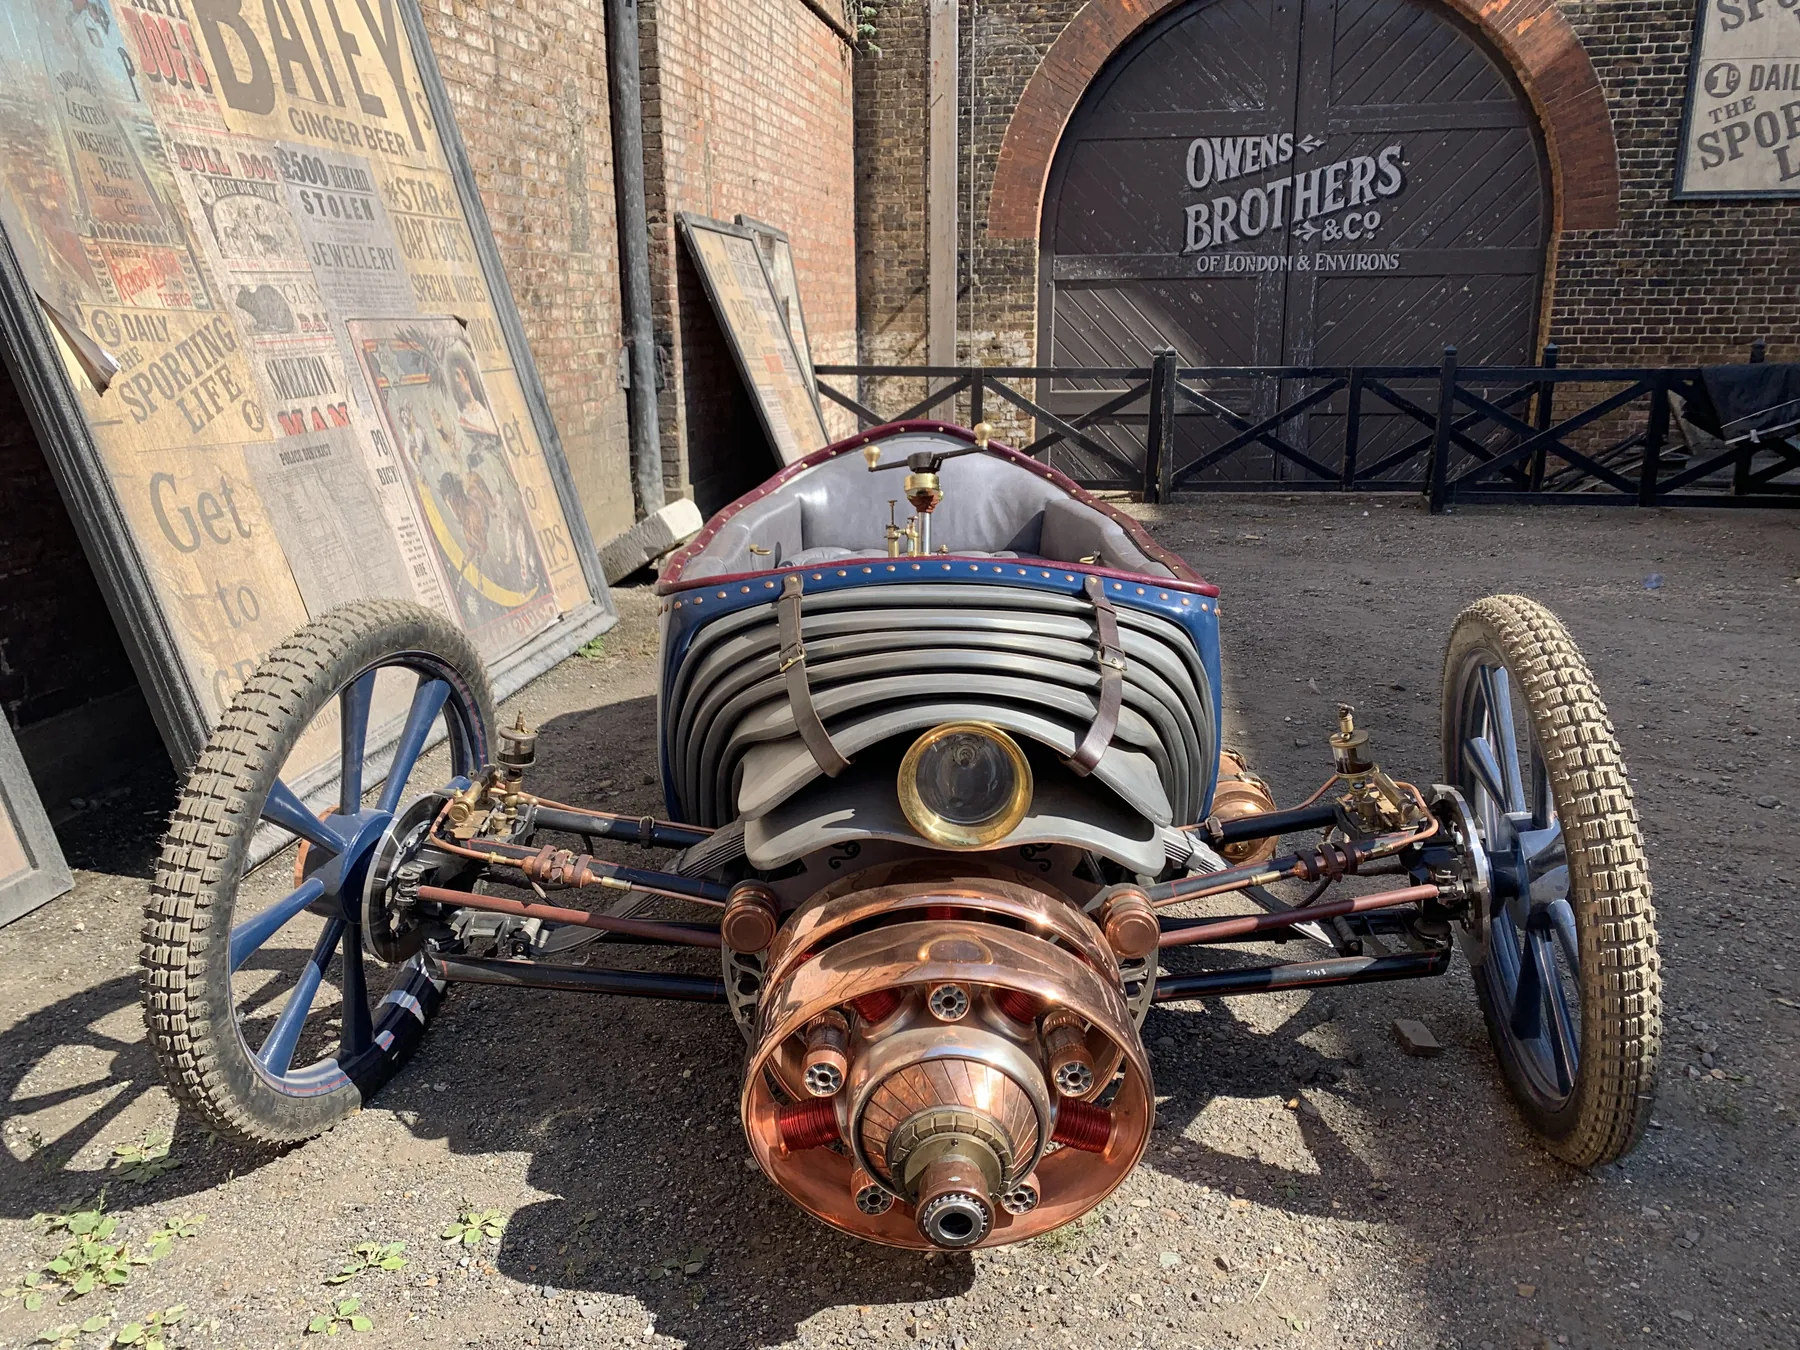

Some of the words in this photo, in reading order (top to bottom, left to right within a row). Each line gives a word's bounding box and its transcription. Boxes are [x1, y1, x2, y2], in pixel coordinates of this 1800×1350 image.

[1709, 95, 1756, 124] THE
[286, 106, 363, 148] GINGER
[361, 124, 410, 158] BEER
[172, 141, 232, 177] BULL
[236, 151, 280, 183] DOG
[1187, 133, 1294, 188] OWENS
[300, 189, 375, 220] STOLEN
[395, 176, 445, 215] STAR
[1183, 145, 1402, 252] BROTHERS
[311, 241, 397, 270] JEWELLERY
[1197, 256, 1221, 272] OF
[1223, 256, 1293, 272] LONDON
[1297, 255, 1311, 271] &
[1315, 253, 1400, 271] ENVIRONS
[157, 292, 192, 308] TERROR
[410, 273, 456, 303] SPECIAL
[452, 276, 487, 303] WIRES
[120, 313, 172, 343] DAILY
[116, 346, 144, 374] THE
[118, 315, 238, 425] SPORTING
[175, 363, 243, 434] LIFE
[277, 401, 352, 437] MAN
[279, 447, 303, 466] POLICE
[301, 443, 332, 463] DISTRICT
[150, 472, 252, 553] Get
[216, 579, 260, 629] to
